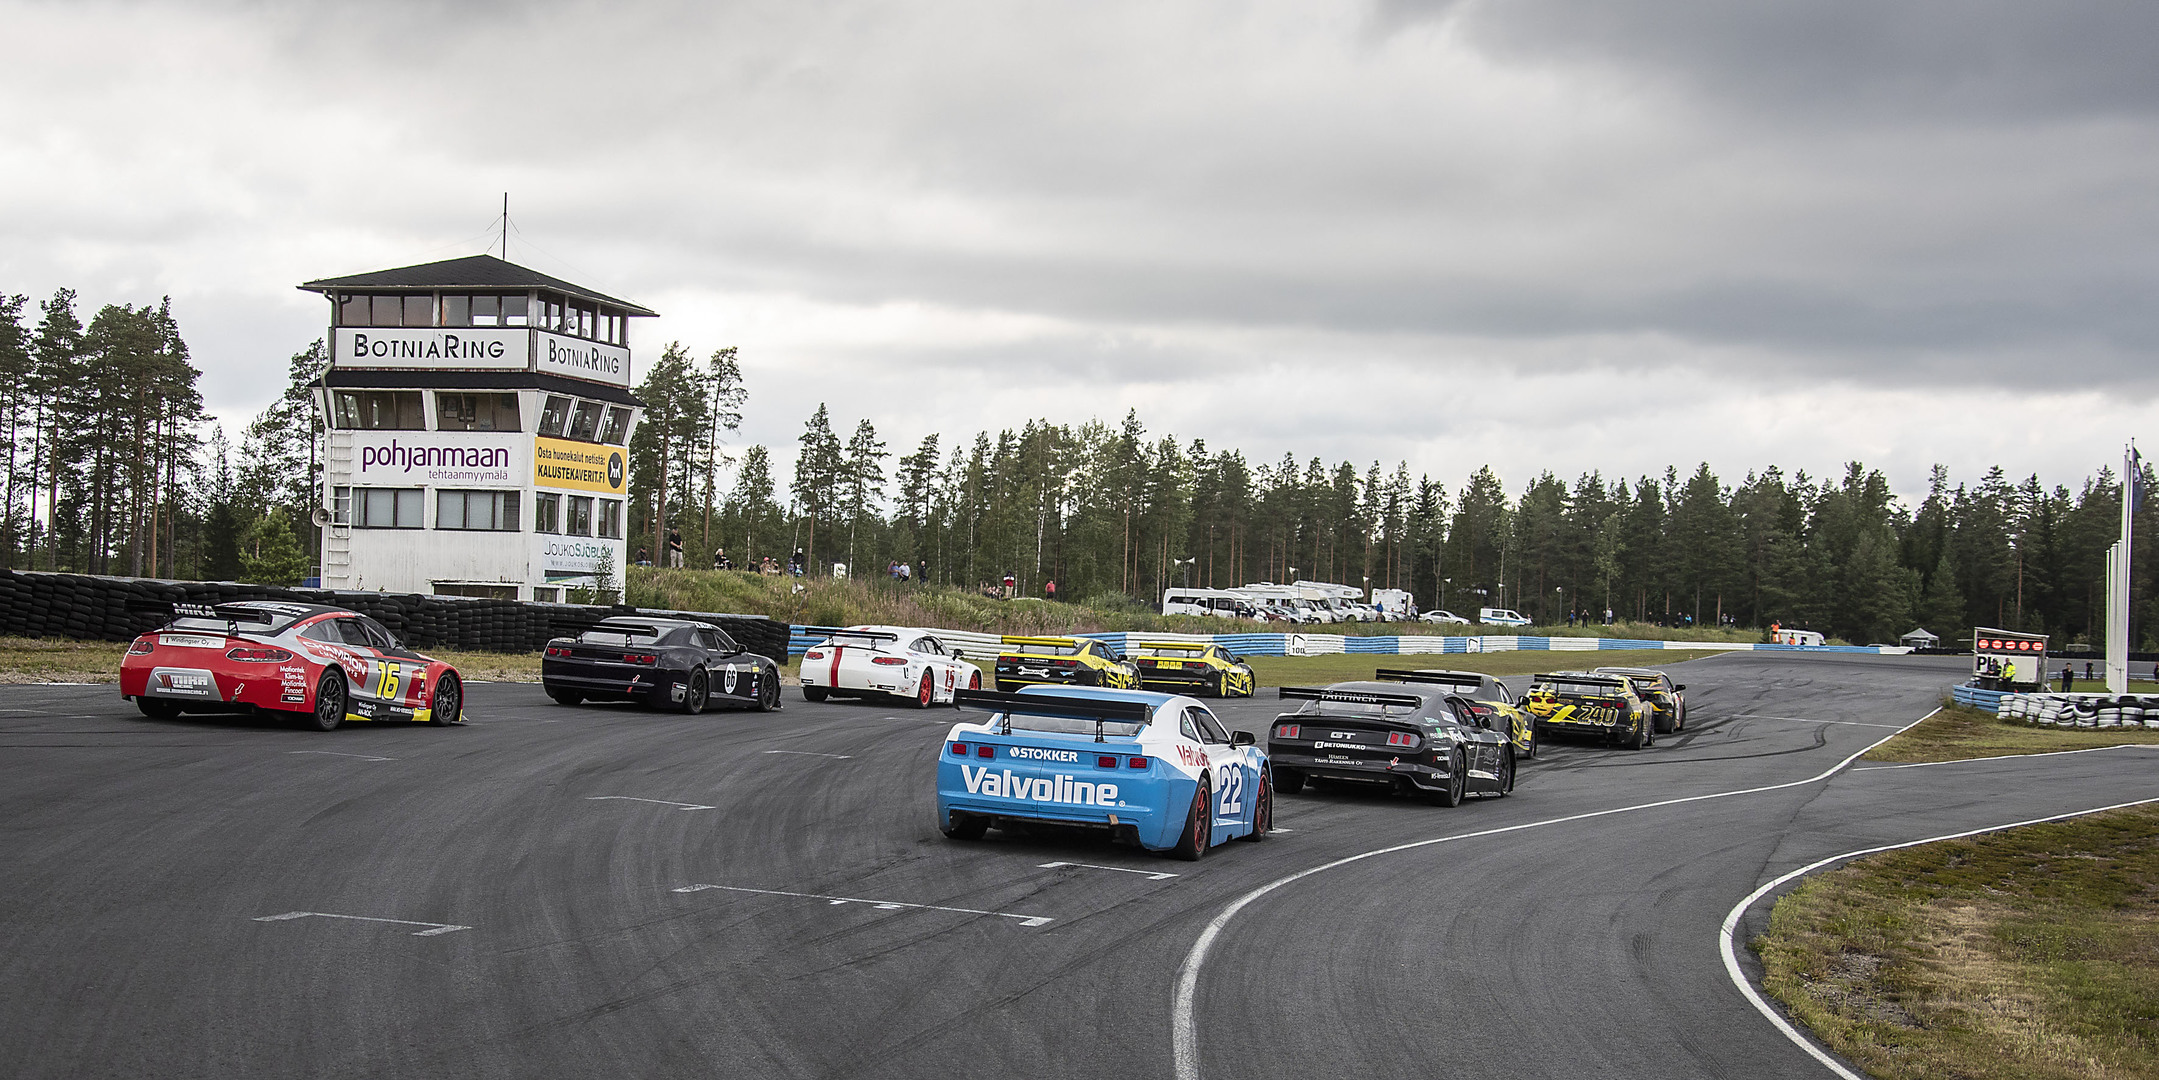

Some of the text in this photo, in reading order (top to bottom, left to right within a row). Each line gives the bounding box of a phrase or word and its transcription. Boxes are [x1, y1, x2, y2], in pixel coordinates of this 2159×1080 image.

[362, 439, 509, 473] pohjanmaan
[537, 446, 606, 466] Osta huonekalut netistä:
[428, 469, 508, 481] tehtaanmyymälä
[537, 464, 606, 484] KALUSTEKAVERIT.FI
[172, 602, 217, 618] MIKA
[201, 638, 210, 646] Oy
[302, 641, 367, 676] CHAMPION
[377, 660, 401, 701] 16
[726, 669, 736, 688] 66
[1576, 705, 1620, 727] 240
[1330, 731, 1356, 740] GT
[1019, 747, 1078, 763] STOKKER
[1323, 742, 1367, 751] BETONIUKKO
[960, 764, 1119, 808] Valvoline
[1219, 764, 1243, 816] 22
